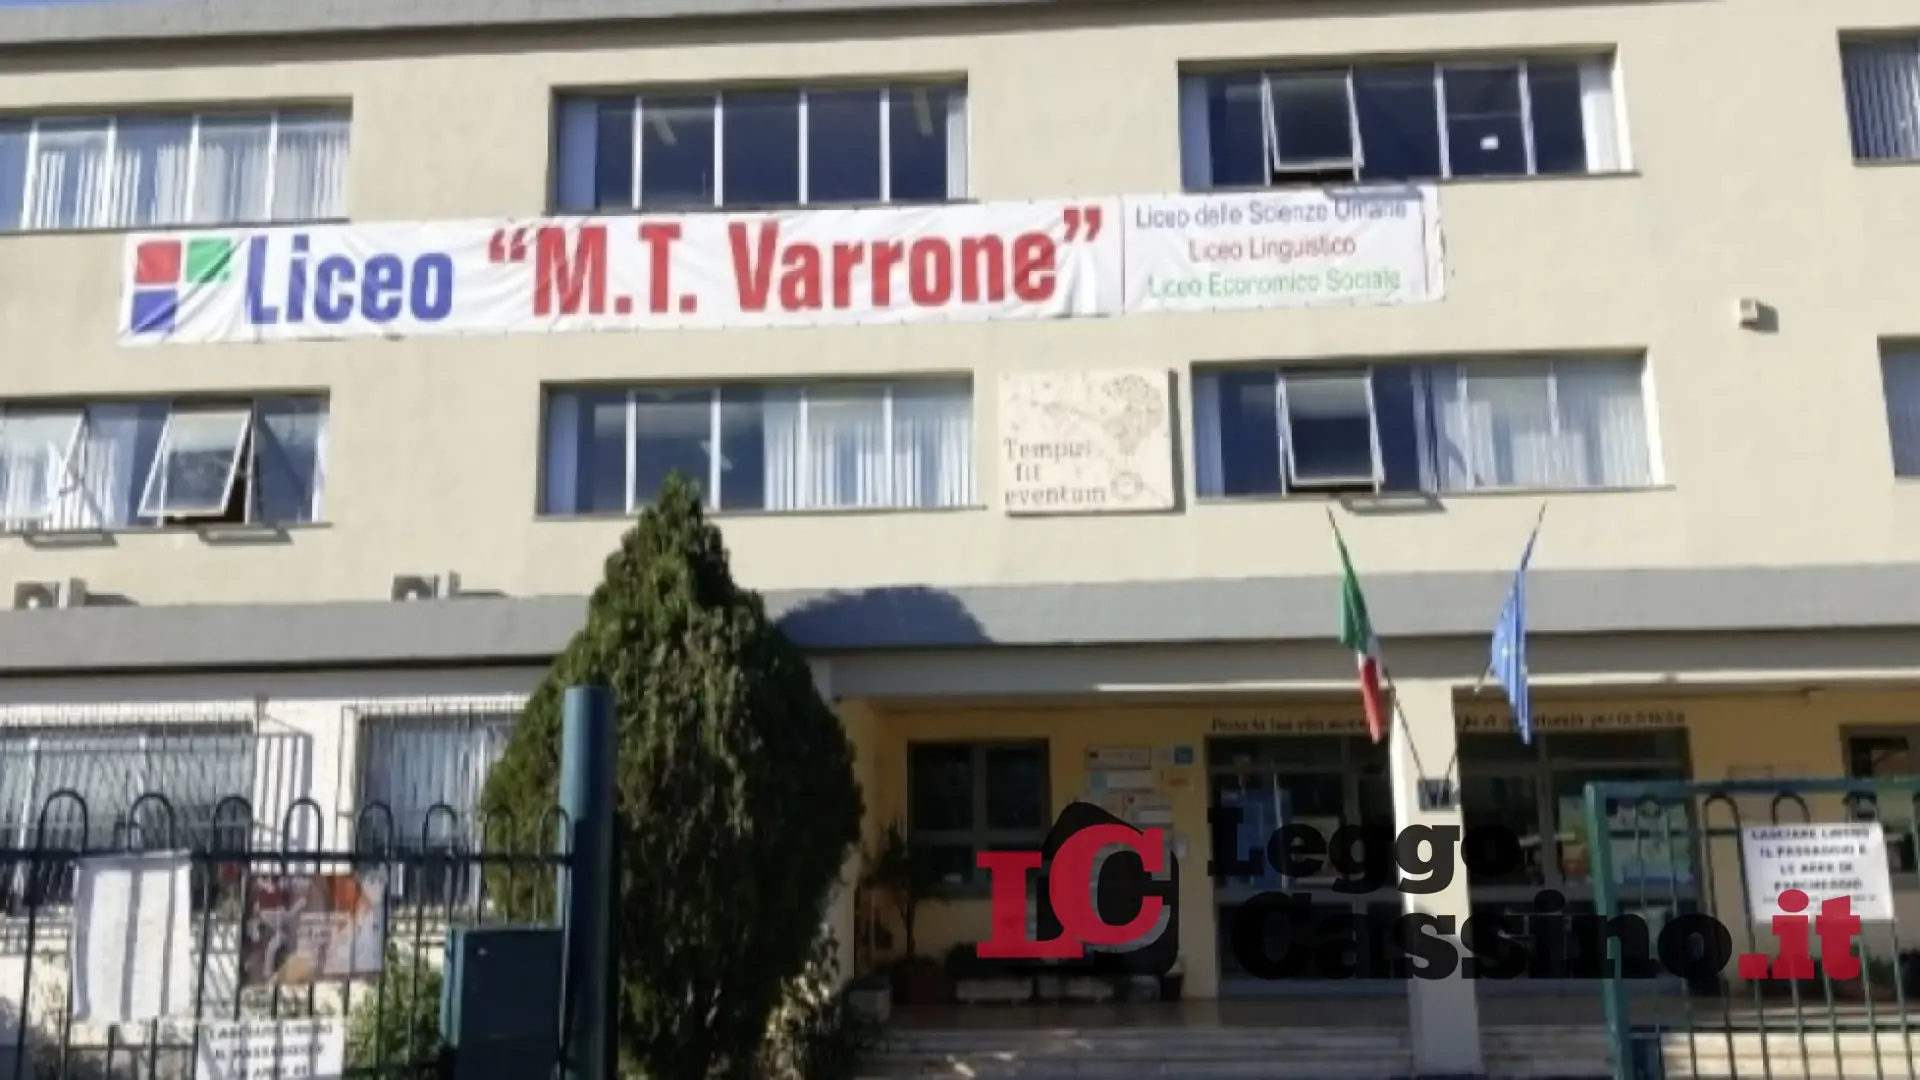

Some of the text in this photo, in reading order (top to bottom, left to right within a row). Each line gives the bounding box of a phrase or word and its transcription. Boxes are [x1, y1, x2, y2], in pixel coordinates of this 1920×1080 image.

[1135, 197, 1408, 229] Liceo delle Scienze Umane
[1188, 235, 1357, 263] Liceo Linguistico
[245, 234, 453, 326] Liceo
[1148, 267, 1402, 298] Liceo Economico Sociale
